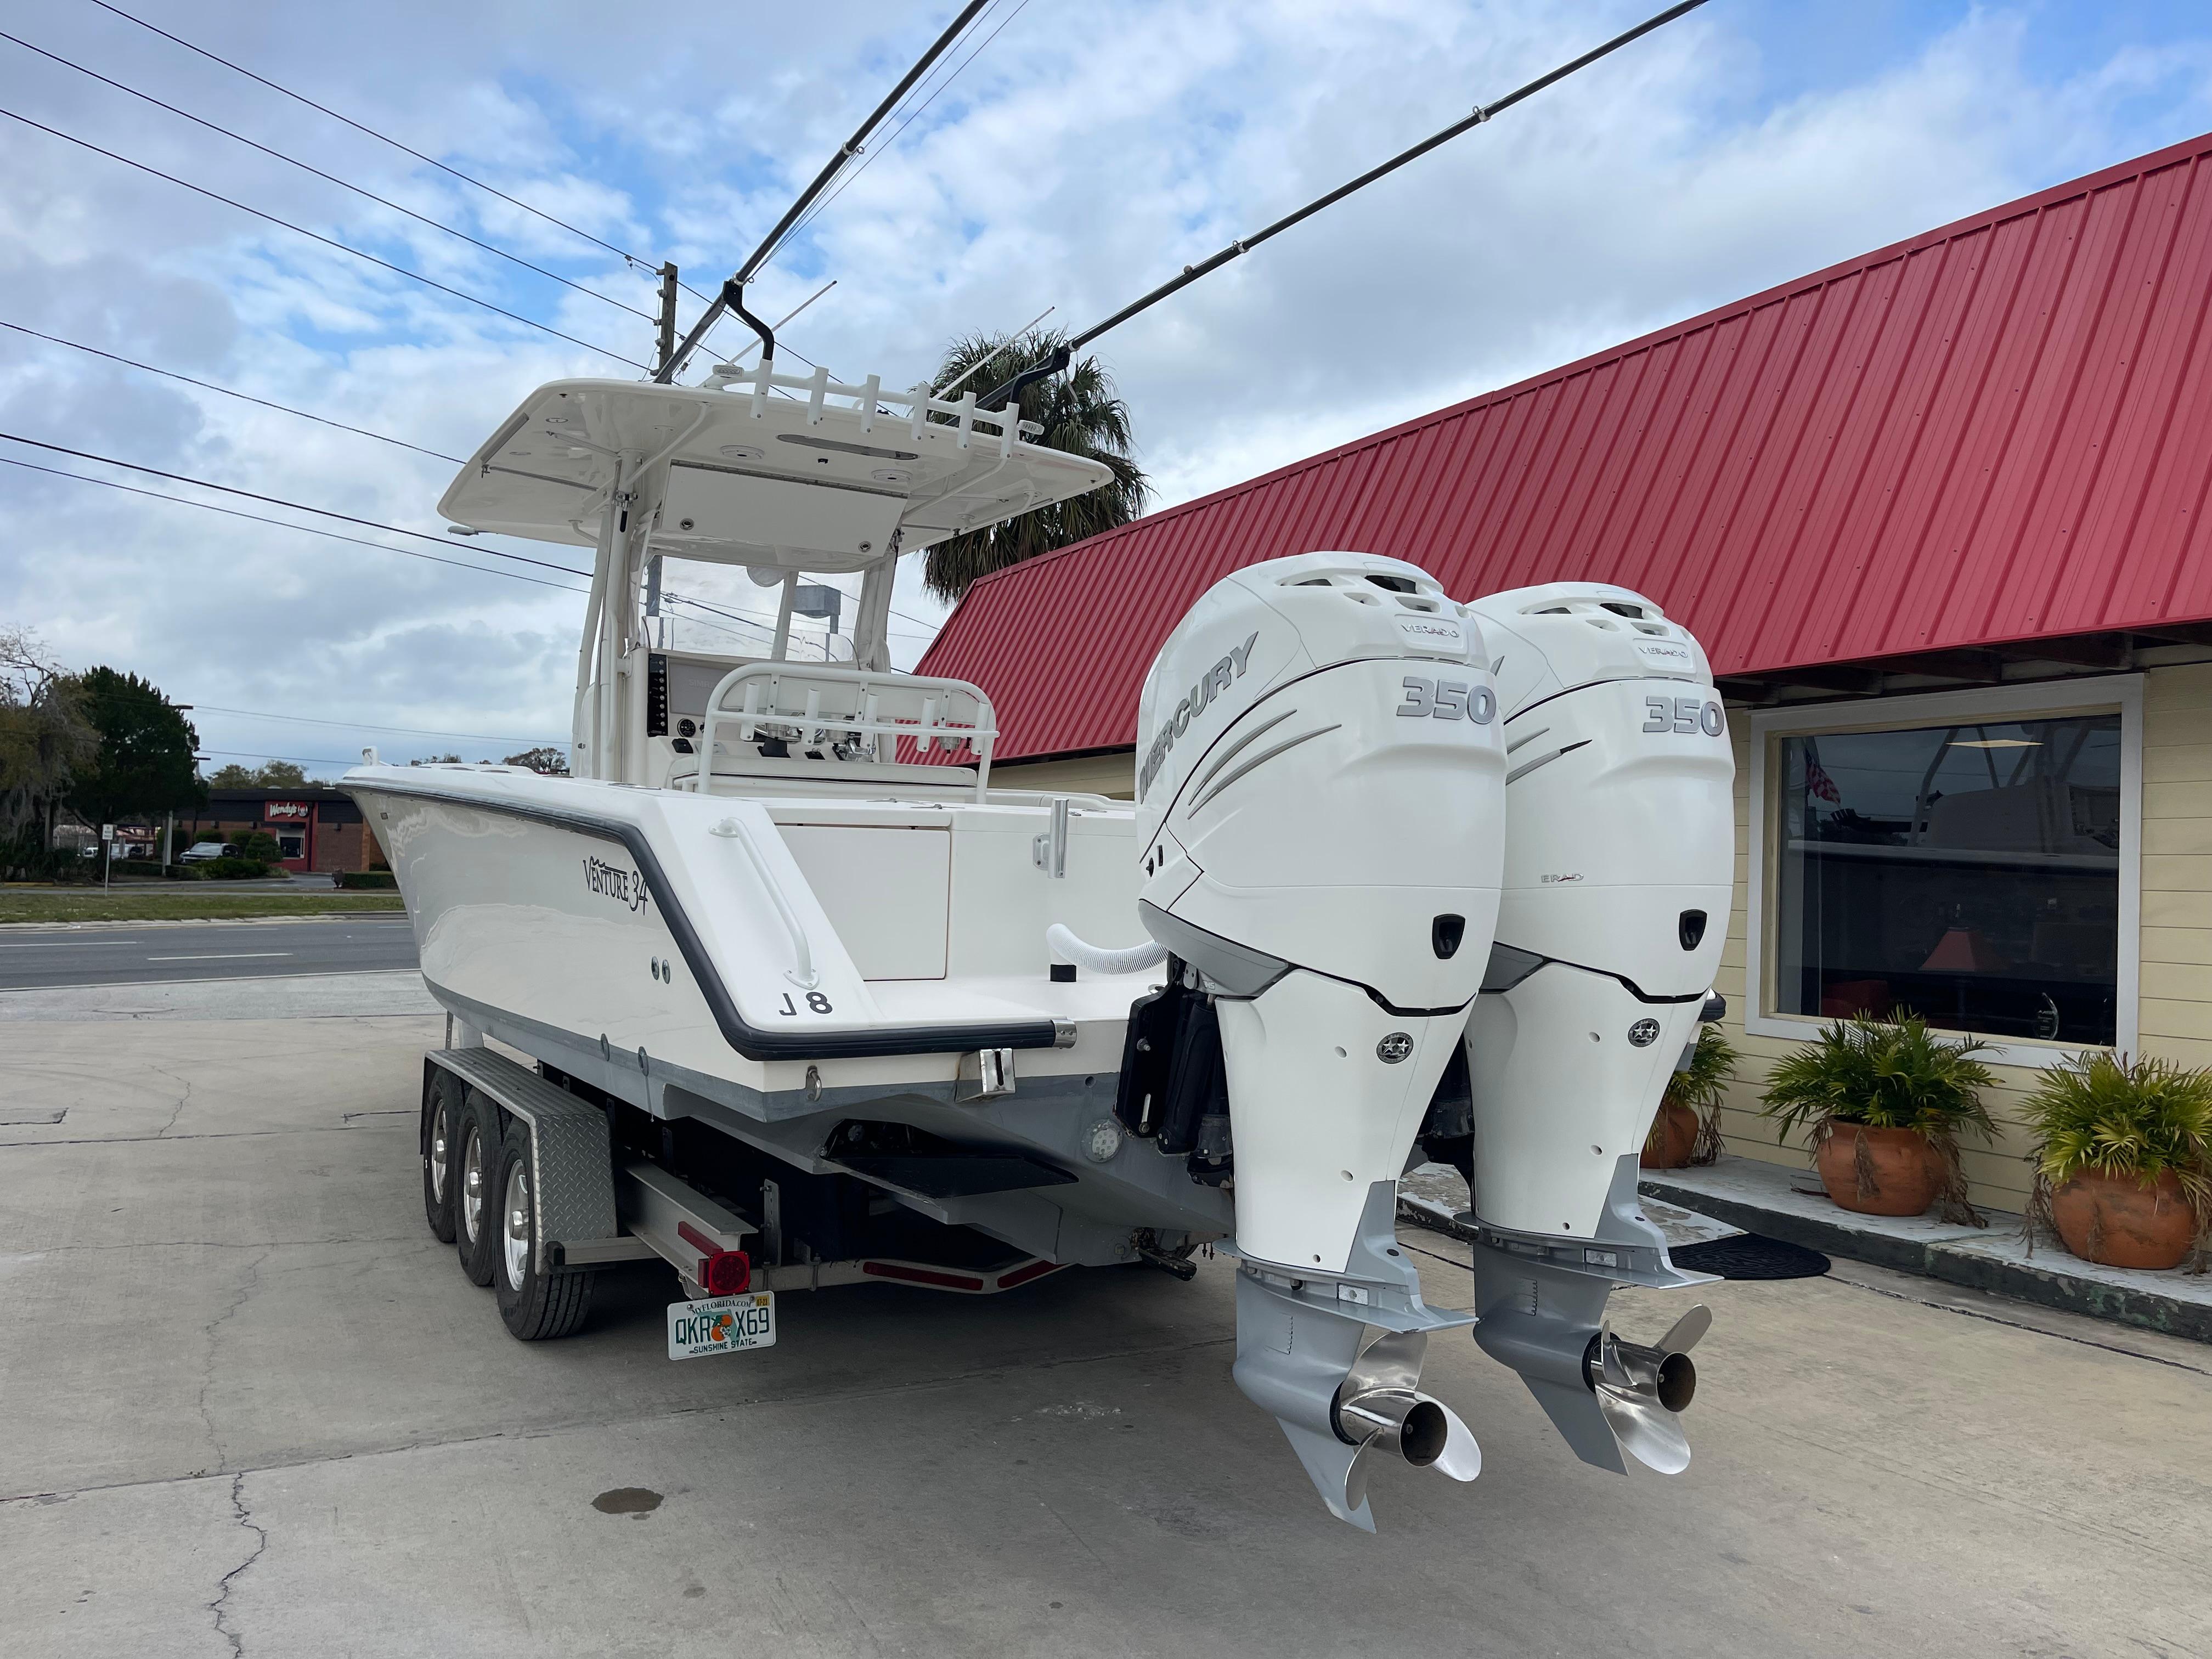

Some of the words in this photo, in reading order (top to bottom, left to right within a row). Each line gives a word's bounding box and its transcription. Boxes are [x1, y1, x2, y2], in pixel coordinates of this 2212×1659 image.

[1401, 623, 1460, 638] VERADO
[1139, 630, 1259, 805] MERCURY
[1396, 676, 1497, 725] 350
[1643, 695, 1725, 737] 350
[269, 802, 297, 817] Wendy's
[583, 855, 629, 902] VENTURE
[629, 870, 648, 916] 34
[1541, 873, 1584, 883] ERAD
[675, 1316, 712, 1345] QKR
[735, 1307, 770, 1338] X69
[693, 1341, 728, 1354] SUNSHINE
[731, 1338, 752, 1348] STATE
